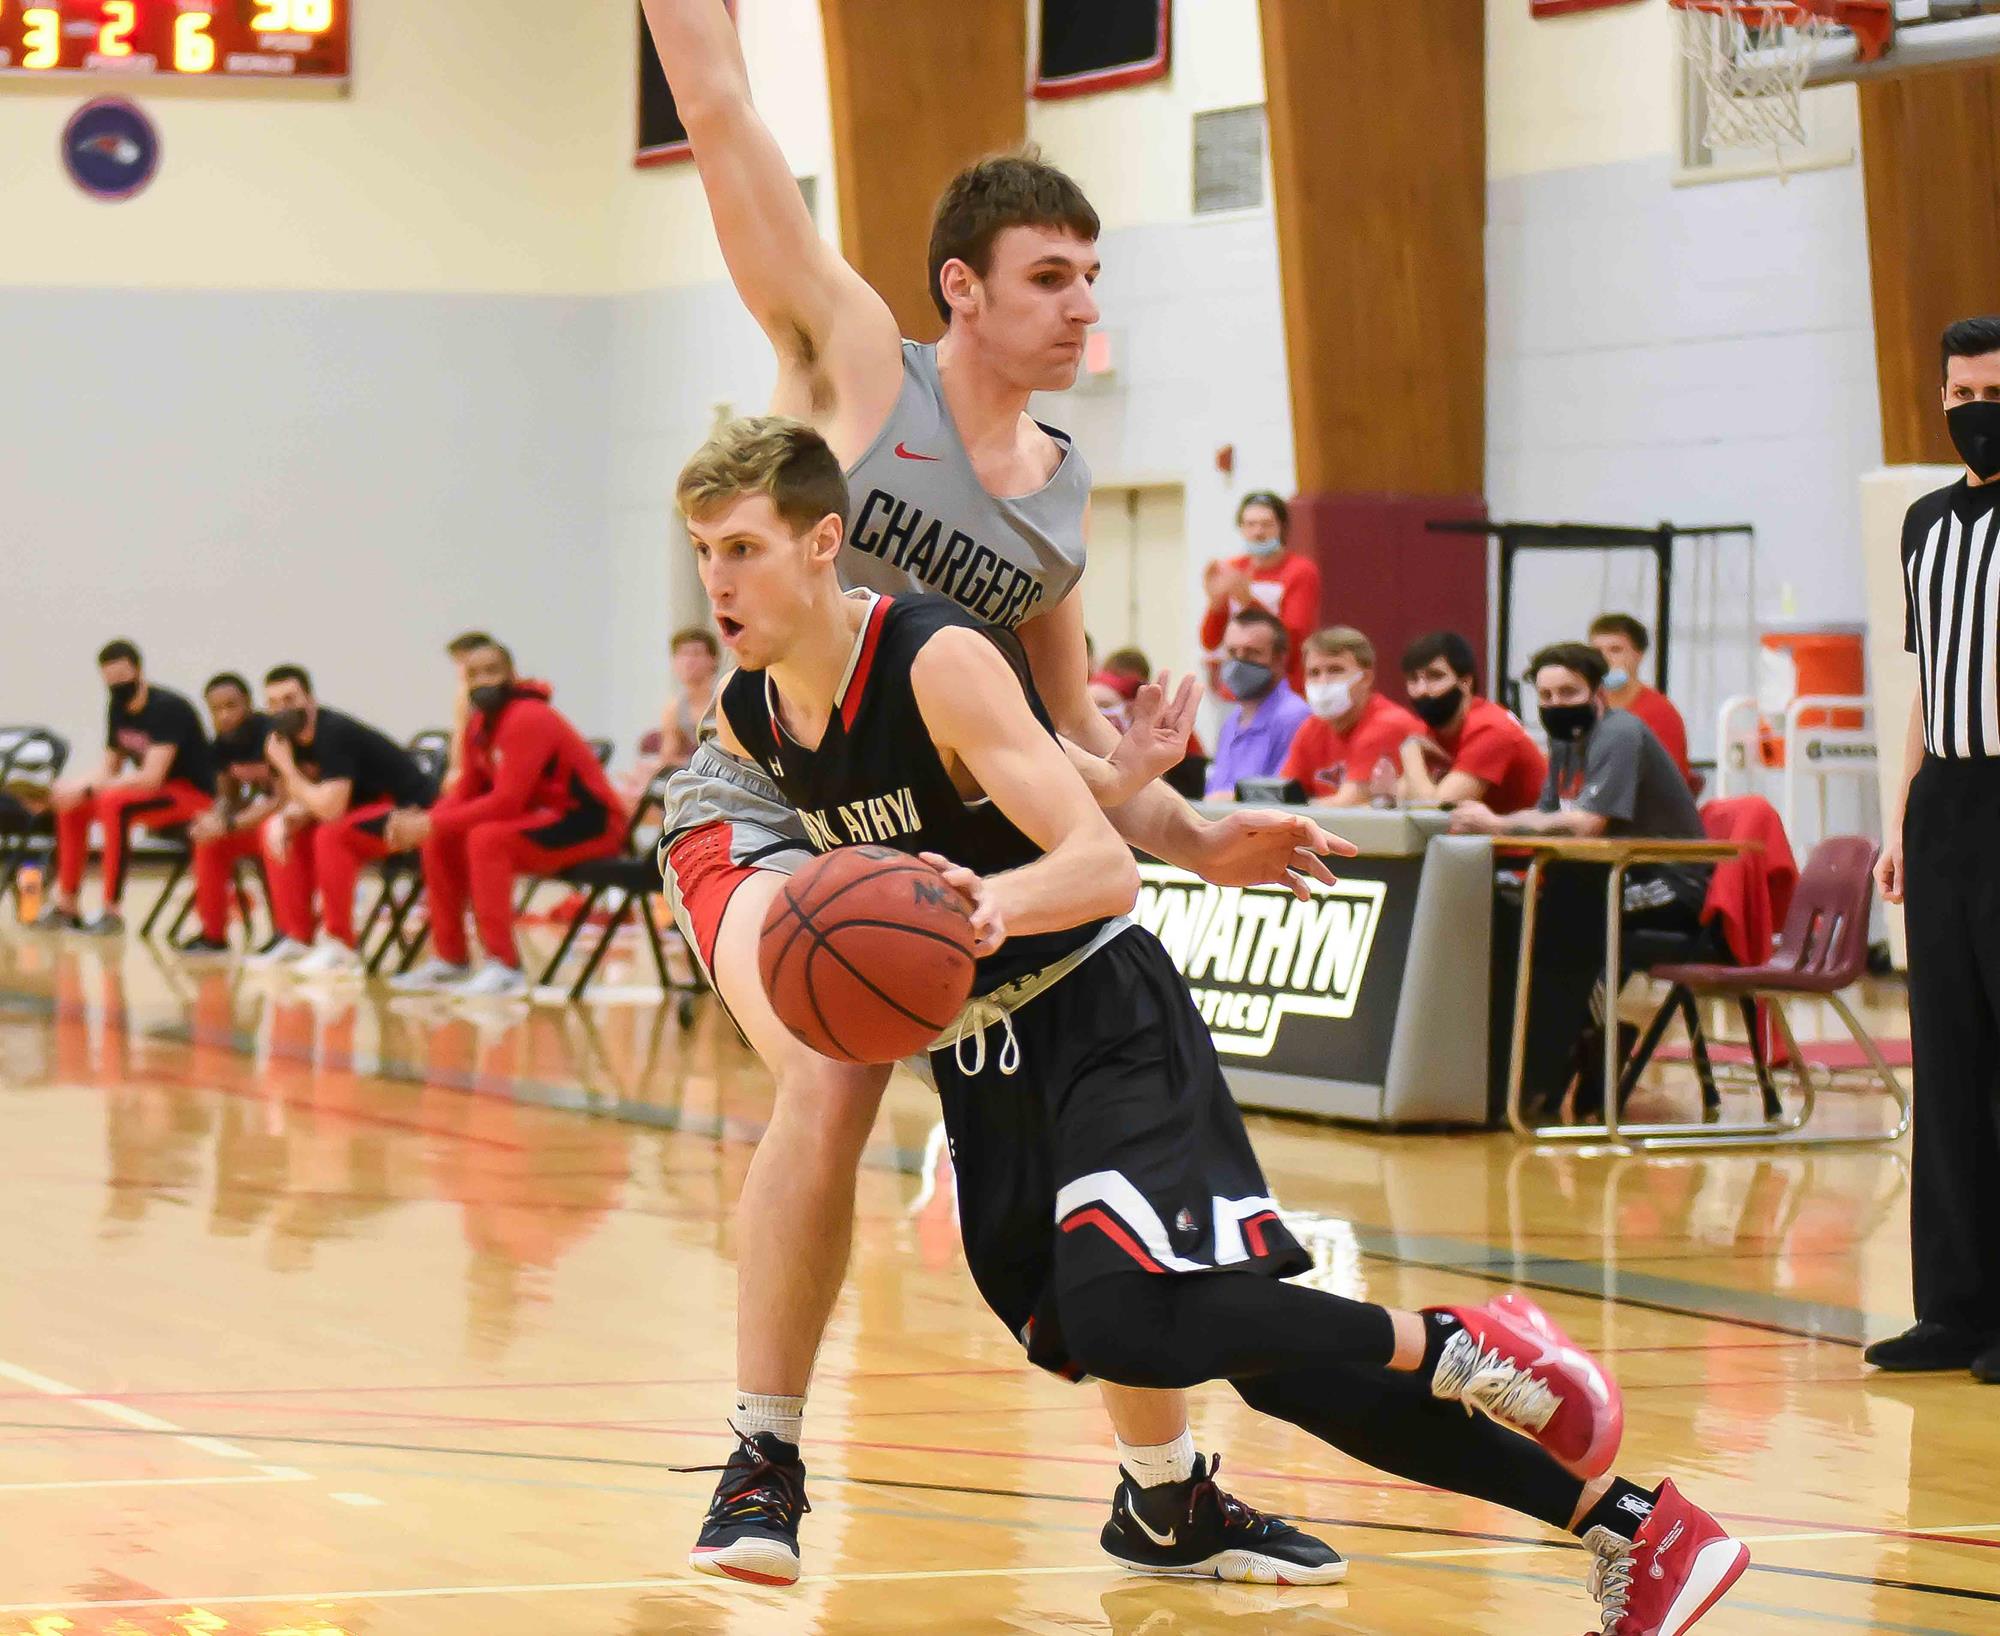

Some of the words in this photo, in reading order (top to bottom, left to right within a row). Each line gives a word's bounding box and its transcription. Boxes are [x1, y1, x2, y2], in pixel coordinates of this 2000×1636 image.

[22, 8, 60, 69] 3
[98, 0, 136, 57] 2
[174, 12, 215, 73] 6
[849, 488, 1044, 631] CHARGERS
